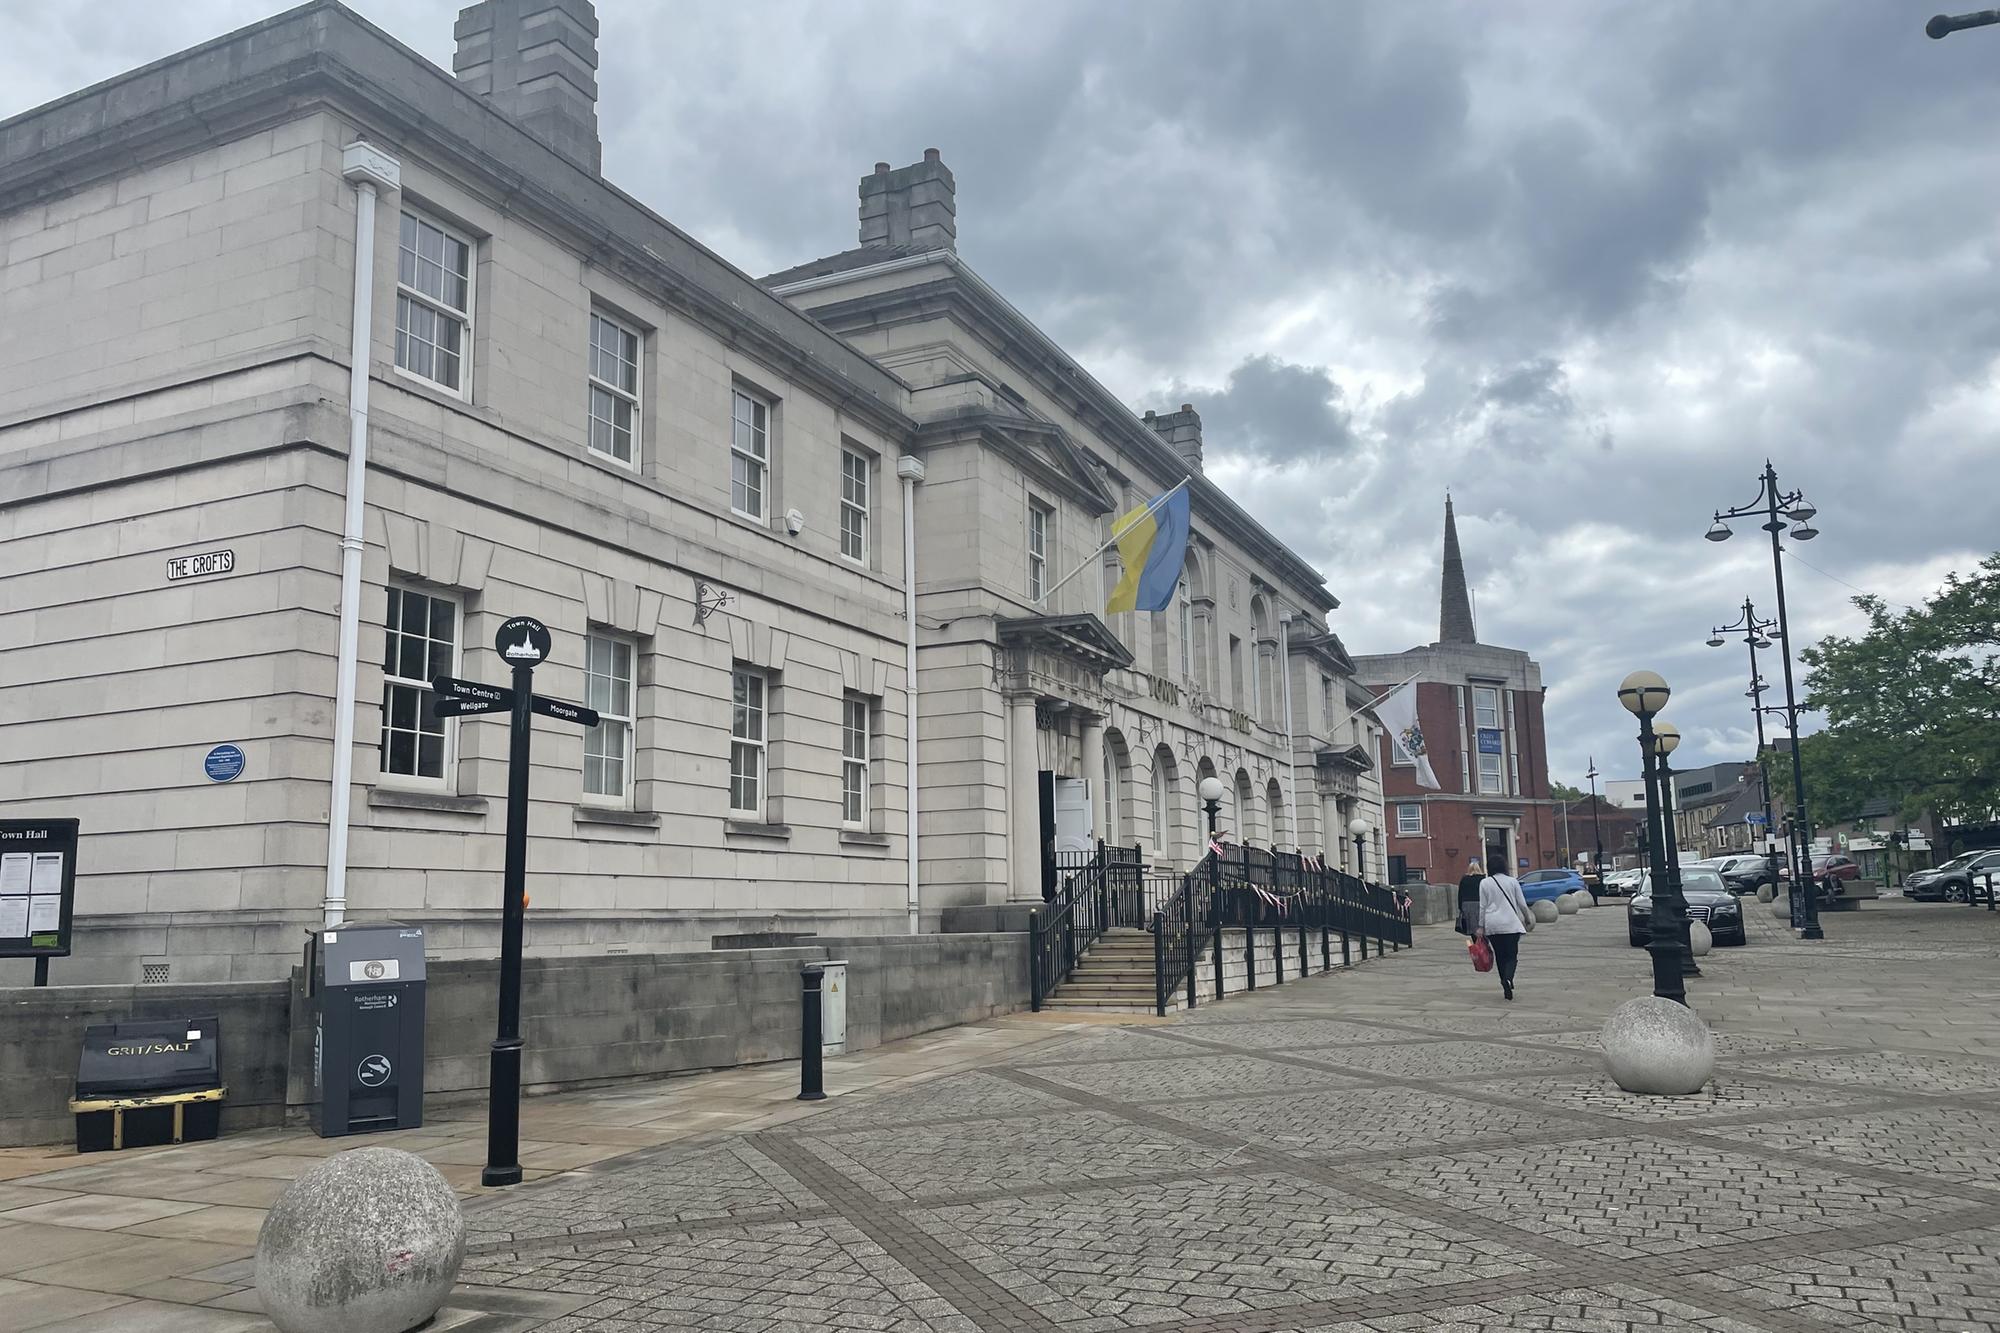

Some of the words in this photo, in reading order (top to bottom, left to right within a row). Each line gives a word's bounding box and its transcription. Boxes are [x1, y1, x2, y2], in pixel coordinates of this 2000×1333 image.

[170, 559, 188, 578] THE
[193, 552, 230, 574] CROFTS
[506, 620, 525, 630] Town
[527, 620, 541, 632] Hall
[452, 682, 471, 694] Town
[471, 686, 495, 699] Centre
[460, 701, 489, 711] Wellgate
[550, 703, 578, 718] Moorgate
[26, 830, 48, 839] Hall
[354, 995, 387, 1003] Rotherham
[107, 1042, 193, 1056] GRIT/SALT
